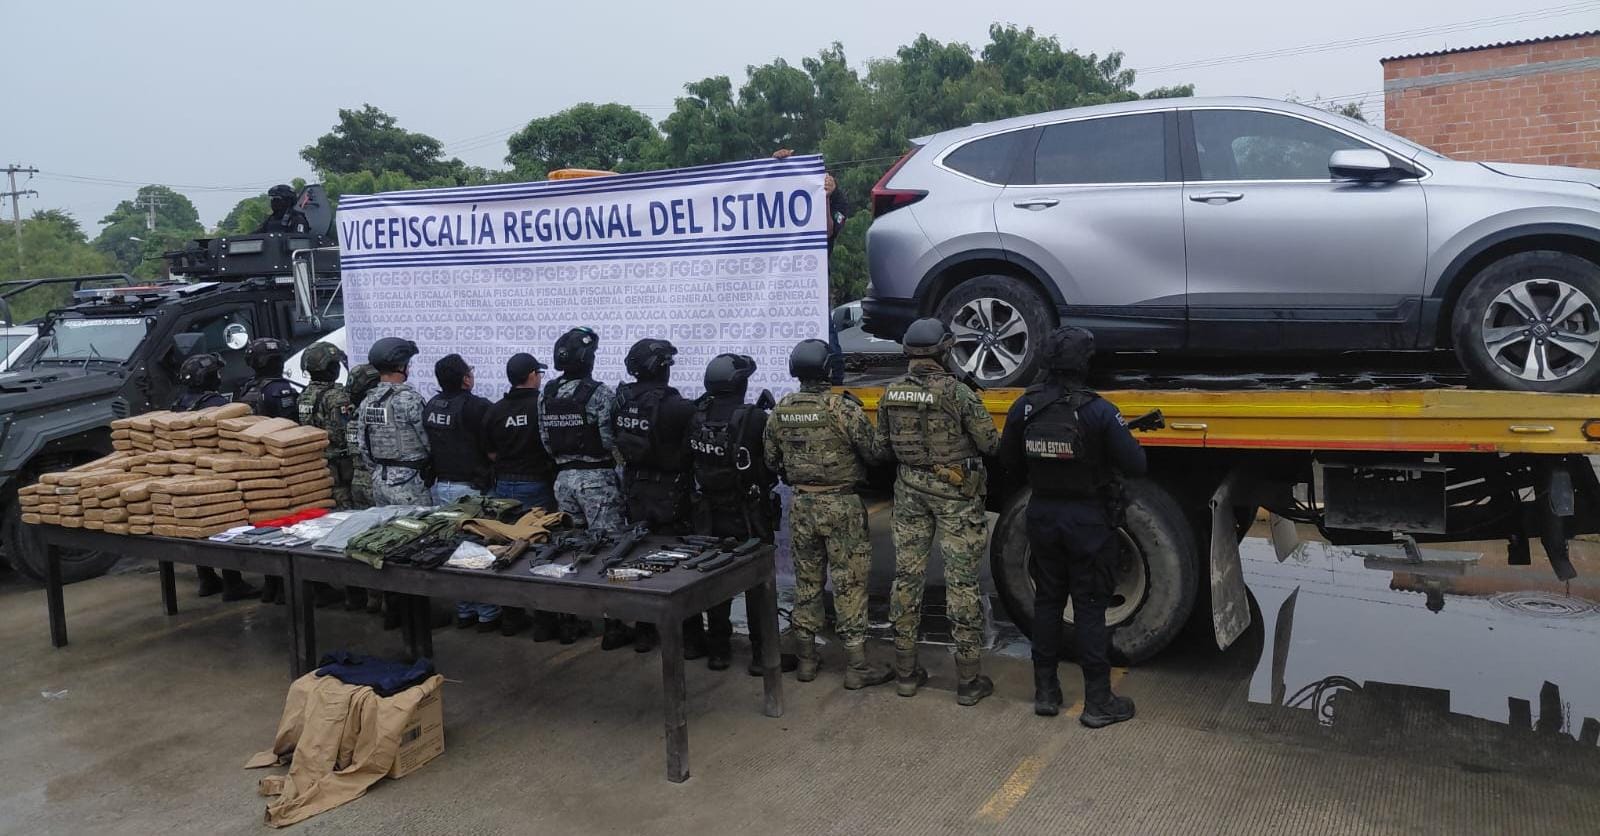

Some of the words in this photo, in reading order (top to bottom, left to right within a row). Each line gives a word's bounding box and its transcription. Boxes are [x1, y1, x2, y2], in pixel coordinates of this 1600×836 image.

[342, 204, 496, 250] VICEFISCALÍA
[503, 203, 642, 244] REGIONAL
[649, 198, 703, 236] DEL
[712, 189, 812, 233] ISTMO
[373, 301, 414, 309] GENERAL
[414, 300, 453, 309] GENERAL
[454, 299, 494, 308] GENERAL
[495, 298, 535, 307] GENERAL
[536, 297, 579, 306] GENERAL
[580, 296, 623, 305] GENERAL
[624, 295, 668, 304] GENERAL
[669, 293, 715, 303] GENERAL
[716, 291, 768, 302] GENERAL
[768, 290, 820, 301] GENERAL
[372, 314, 414, 323] OAXACA
[415, 314, 454, 322] OAXACA
[454, 313, 495, 322] OAXACA
[495, 312, 535, 321] OAXACA
[536, 312, 579, 321] OAXACA
[580, 311, 624, 321] OAXACA
[624, 310, 668, 320] OAXACA
[669, 308, 716, 319] OAXACA
[717, 308, 767, 319] OAXACA
[768, 306, 820, 318] OAXACA
[888, 391, 934, 404] MARINA
[427, 412, 451, 426] AEI
[505, 414, 528, 428] AEI
[616, 415, 649, 430] SSPC
[781, 413, 819, 423] MARINA
[690, 439, 725, 456] SSPC
[1025, 437, 1047, 454] POLICÍA
[1047, 440, 1074, 454] ESTATAL
